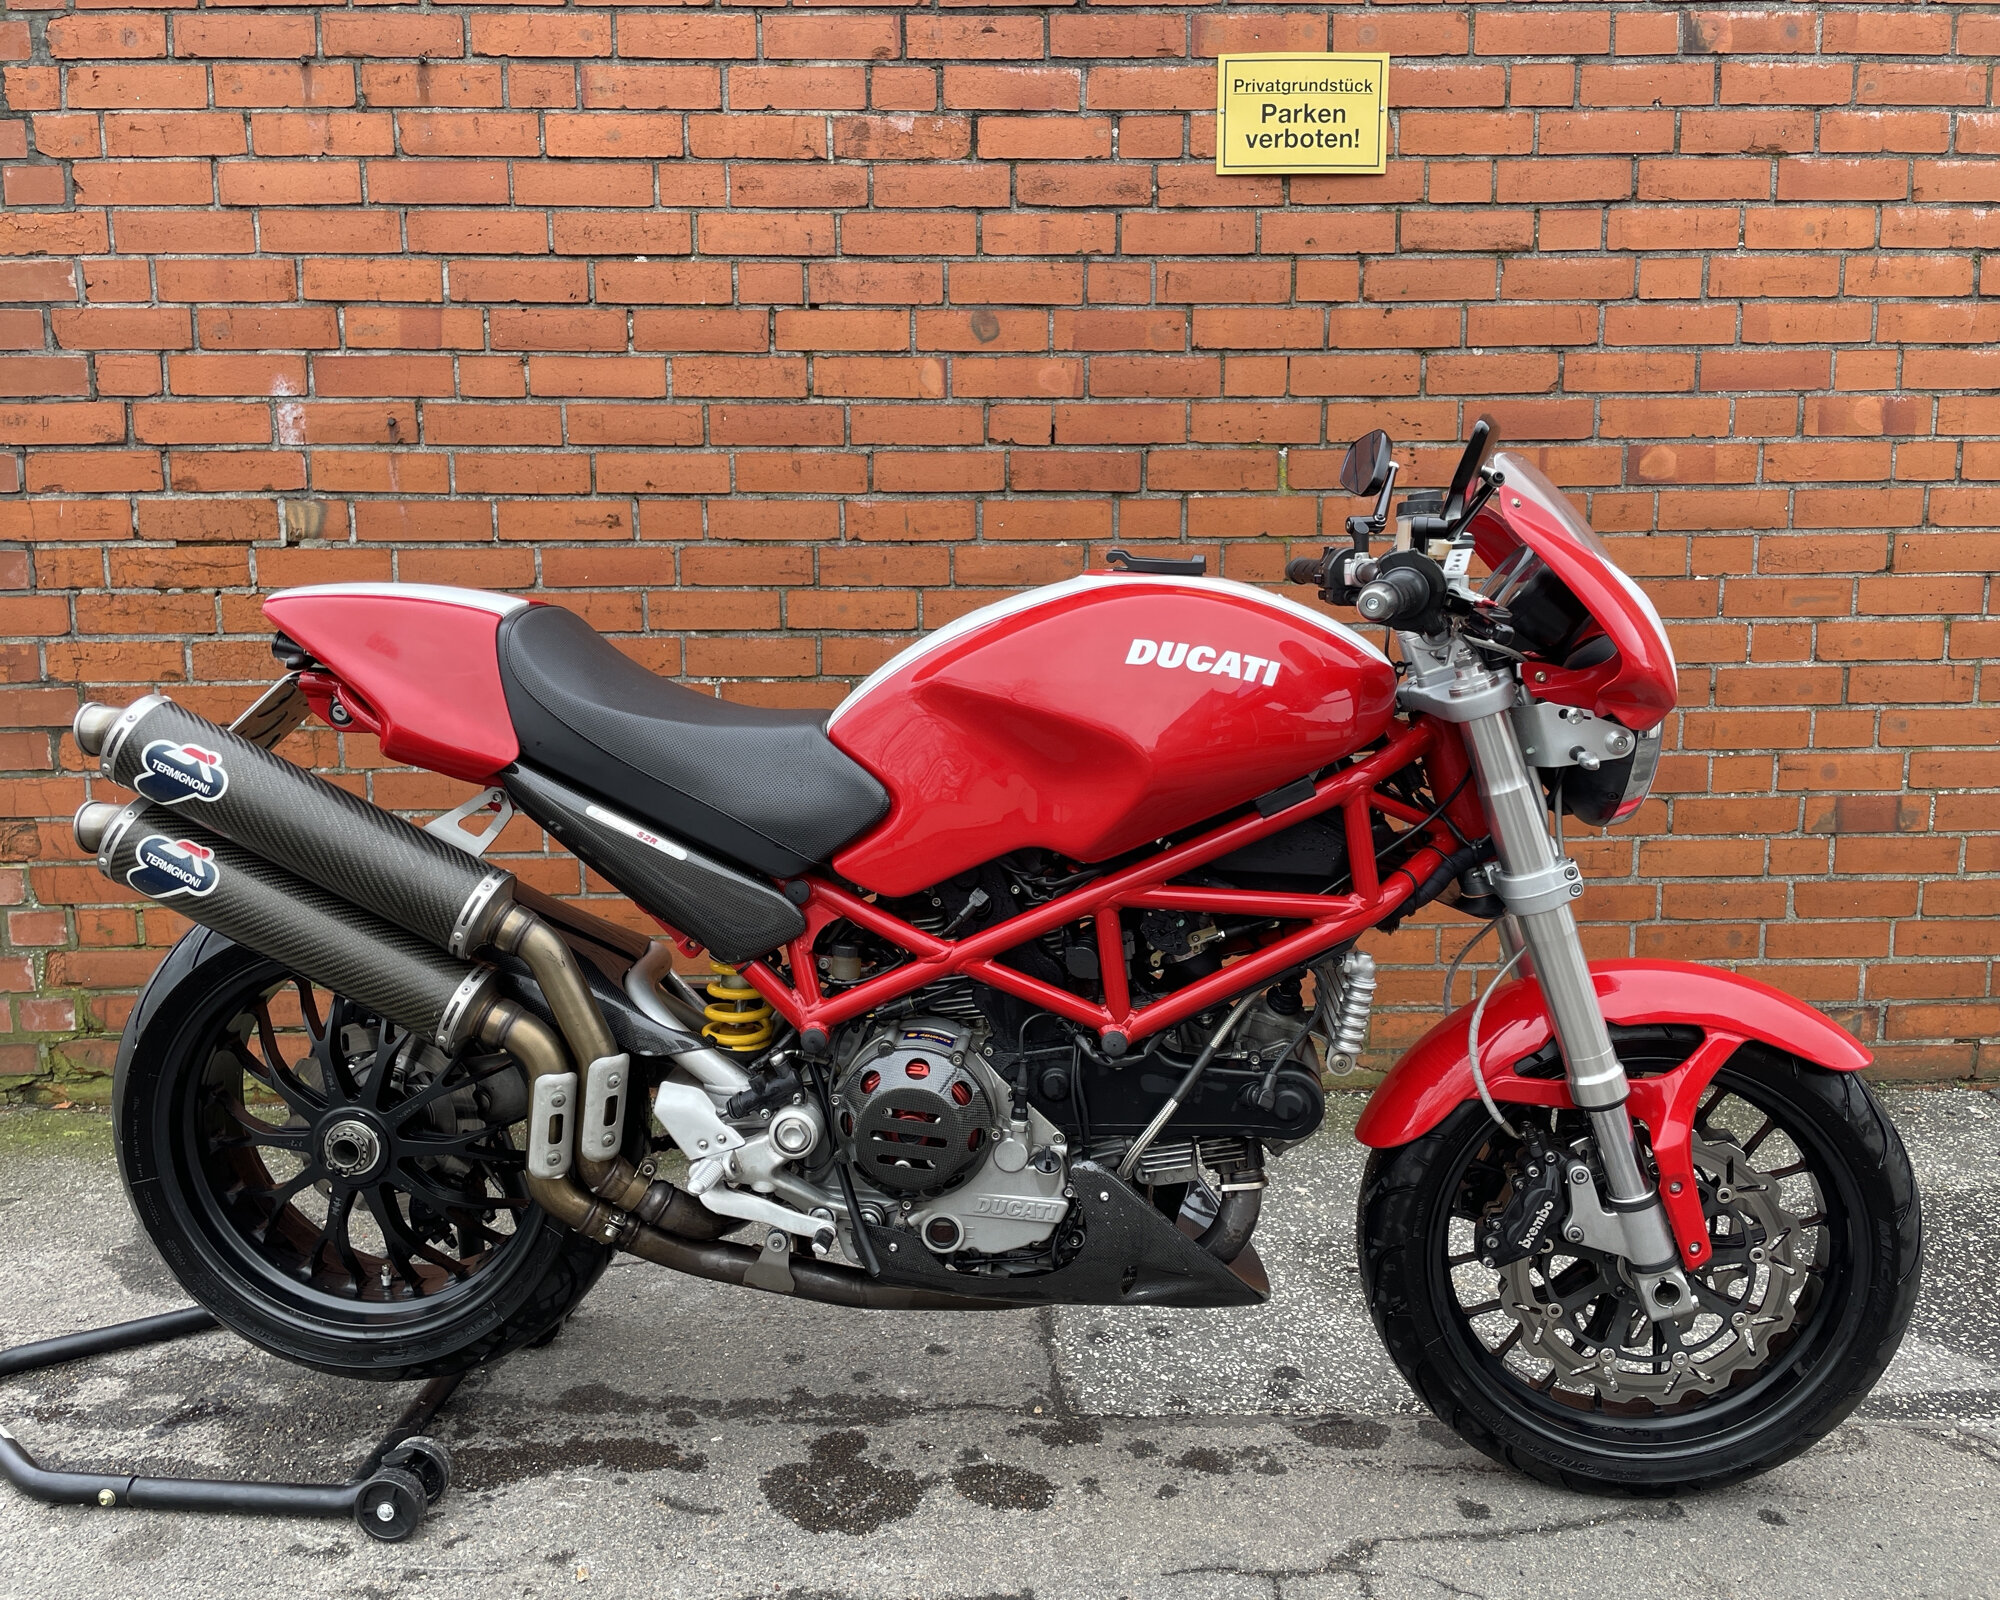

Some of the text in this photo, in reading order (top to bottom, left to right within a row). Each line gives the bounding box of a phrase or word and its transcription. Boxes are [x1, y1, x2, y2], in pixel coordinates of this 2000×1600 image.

[1233, 78, 1373, 95] Privatgrundstück
[1261, 103, 1346, 123] Parken
[1245, 128, 1360, 149] verboten!
[1125, 638, 1281, 687] DUCATI
[151, 758, 211, 795] TERMIGNONI
[636, 831, 658, 845] S2R
[145, 852, 202, 889] TERMIGNONI
[973, 1197, 1062, 1221] DUCATI
[1517, 1200, 1554, 1250] brembo
